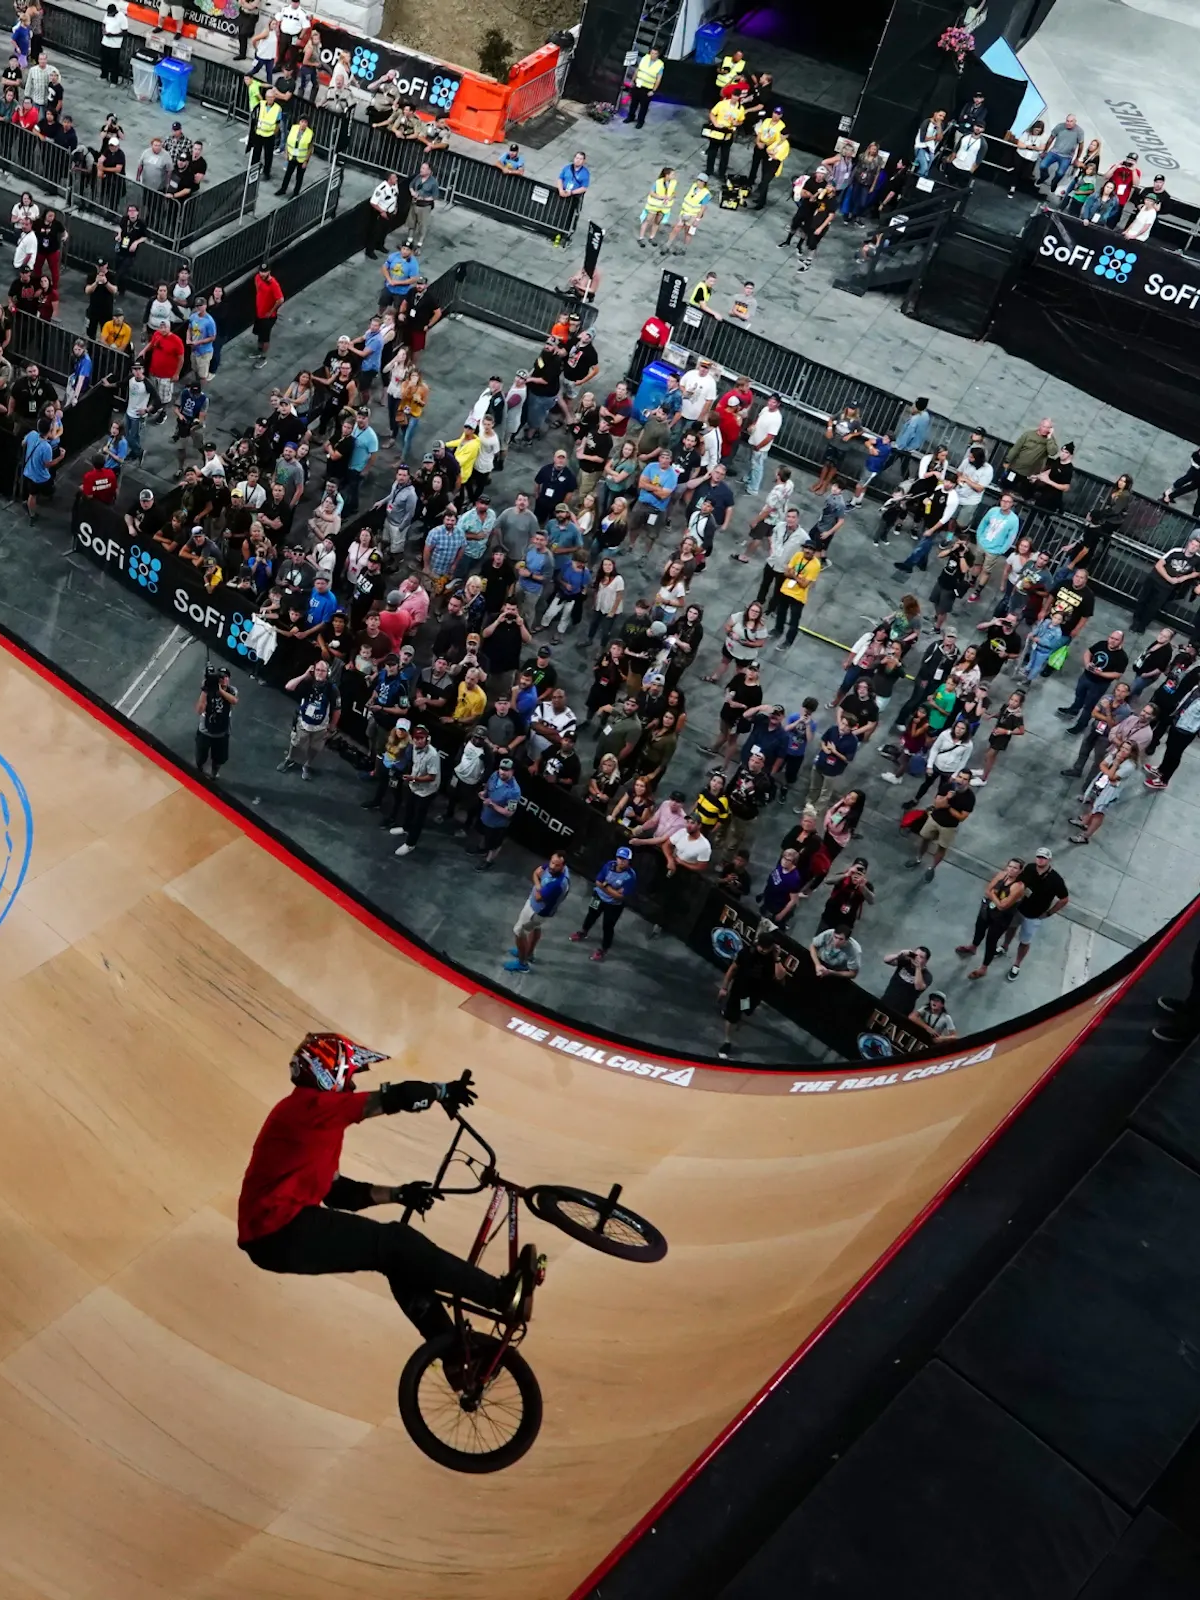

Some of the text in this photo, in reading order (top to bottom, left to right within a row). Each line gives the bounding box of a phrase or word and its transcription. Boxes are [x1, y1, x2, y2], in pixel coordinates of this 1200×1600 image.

[184, 9, 210, 26] FRUIT
[1103, 99, 1180, 170] @XGAMES
[1039, 234, 1095, 271] SoFi
[668, 278, 682, 309] GUESTS
[1144, 273, 1200, 310] SoFi
[77, 521, 125, 570] SoFi
[173, 588, 226, 638] SoFi
[506, 1016, 668, 1079] THE REAL COST
[789, 1056, 968, 1093] THE REAL COST
